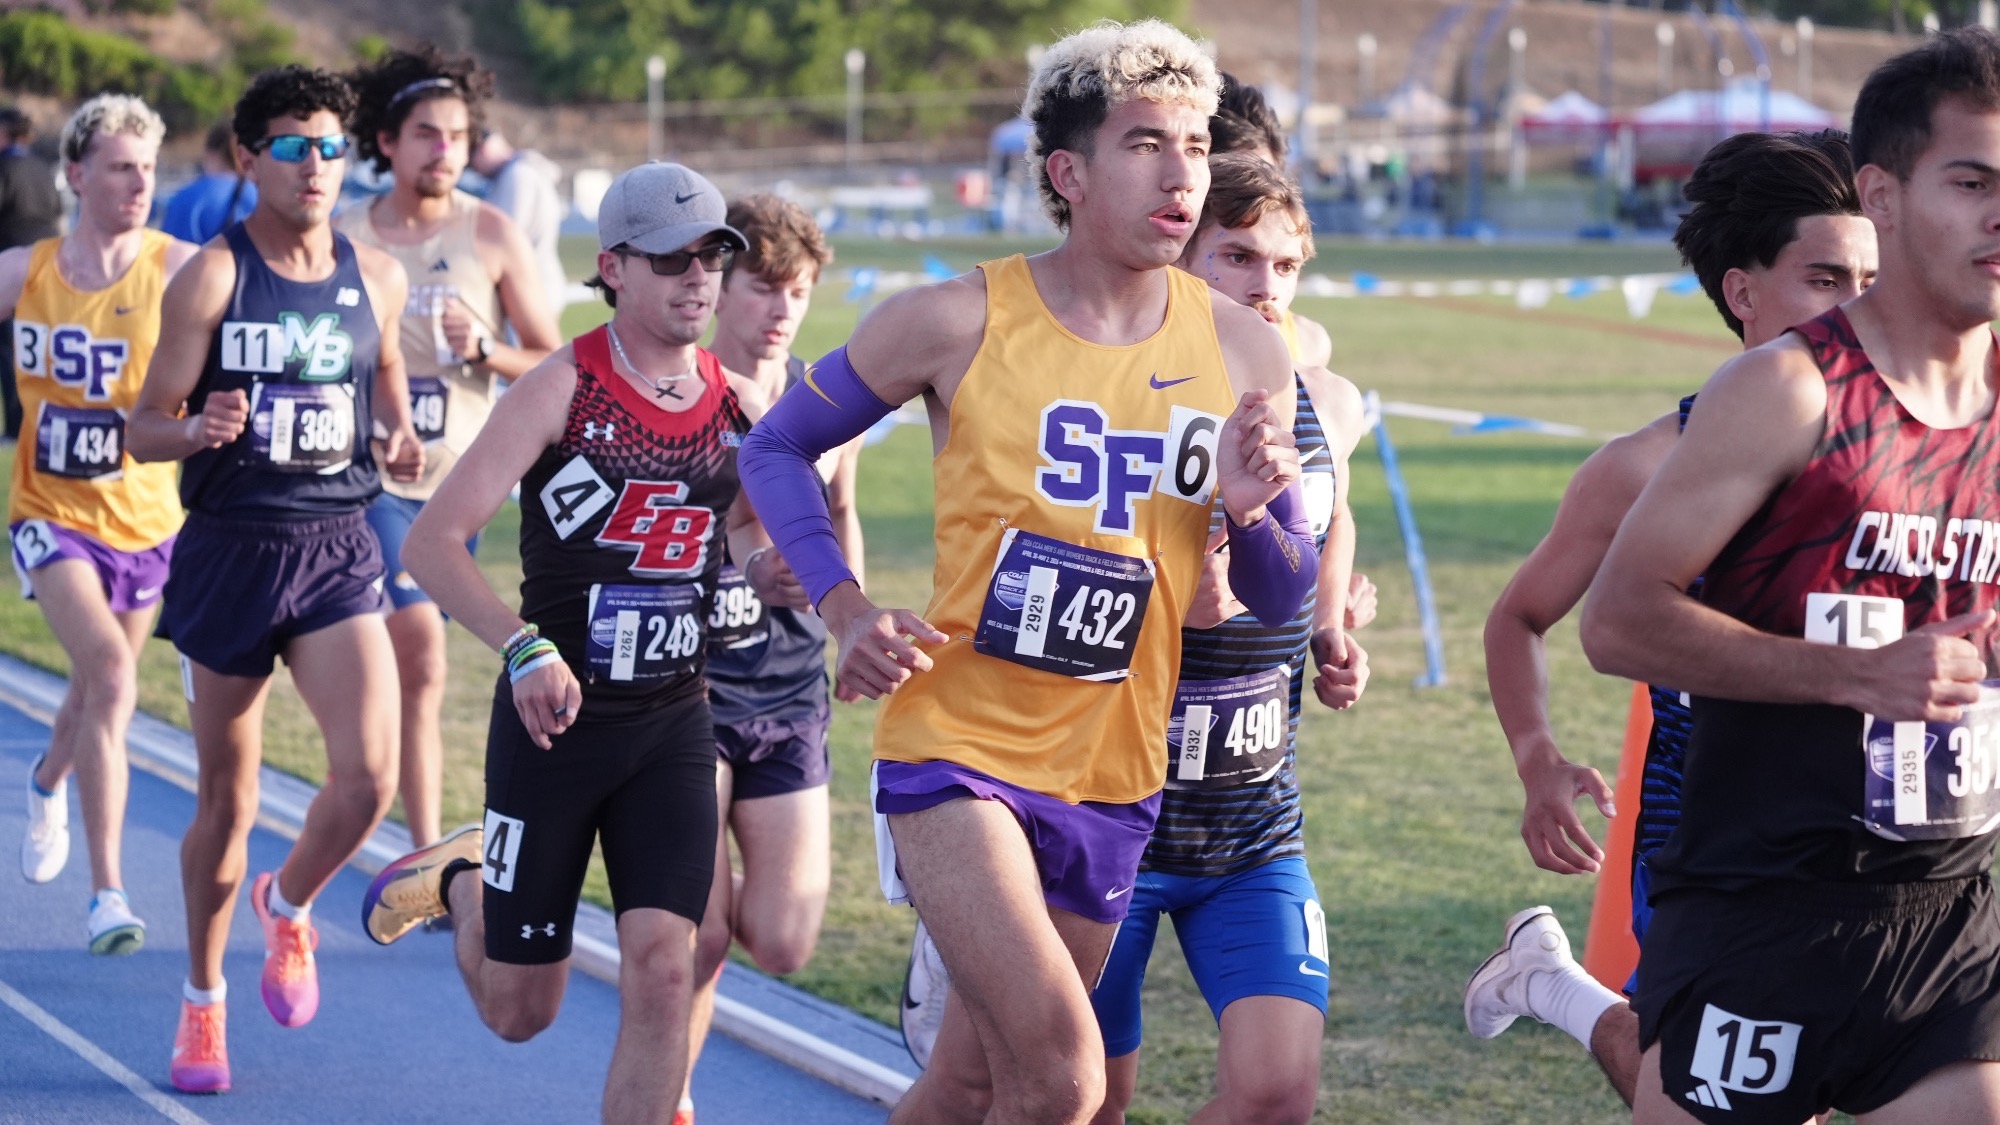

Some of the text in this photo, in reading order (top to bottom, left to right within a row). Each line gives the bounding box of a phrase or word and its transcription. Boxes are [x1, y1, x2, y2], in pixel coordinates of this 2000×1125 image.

[21, 326, 38, 370] 3
[51, 324, 128, 398] SF
[232, 327, 268, 368] 11
[280, 311, 353, 381] MB
[72, 426, 119, 464] 434
[1036, 399, 1167, 537] SF
[1175, 416, 1217, 497] 6
[551, 479, 601, 526] 4
[22, 525, 48, 557] 3
[594, 479, 716, 579] EB
[1845, 510, 1937, 577] CHICO
[708, 586, 762, 628] 395
[1025, 594, 1045, 633] 2929
[1058, 585, 1136, 650] 432
[1825, 600, 1887, 648] 15
[620, 630, 634, 659] 2924
[644, 613, 700, 660] 248
[1185, 729, 1201, 760] 2932
[1224, 698, 1281, 756] 490
[1902, 750, 1917, 794] 2935
[485, 821, 510, 884] 4
[1716, 1019, 1783, 1089] 15
